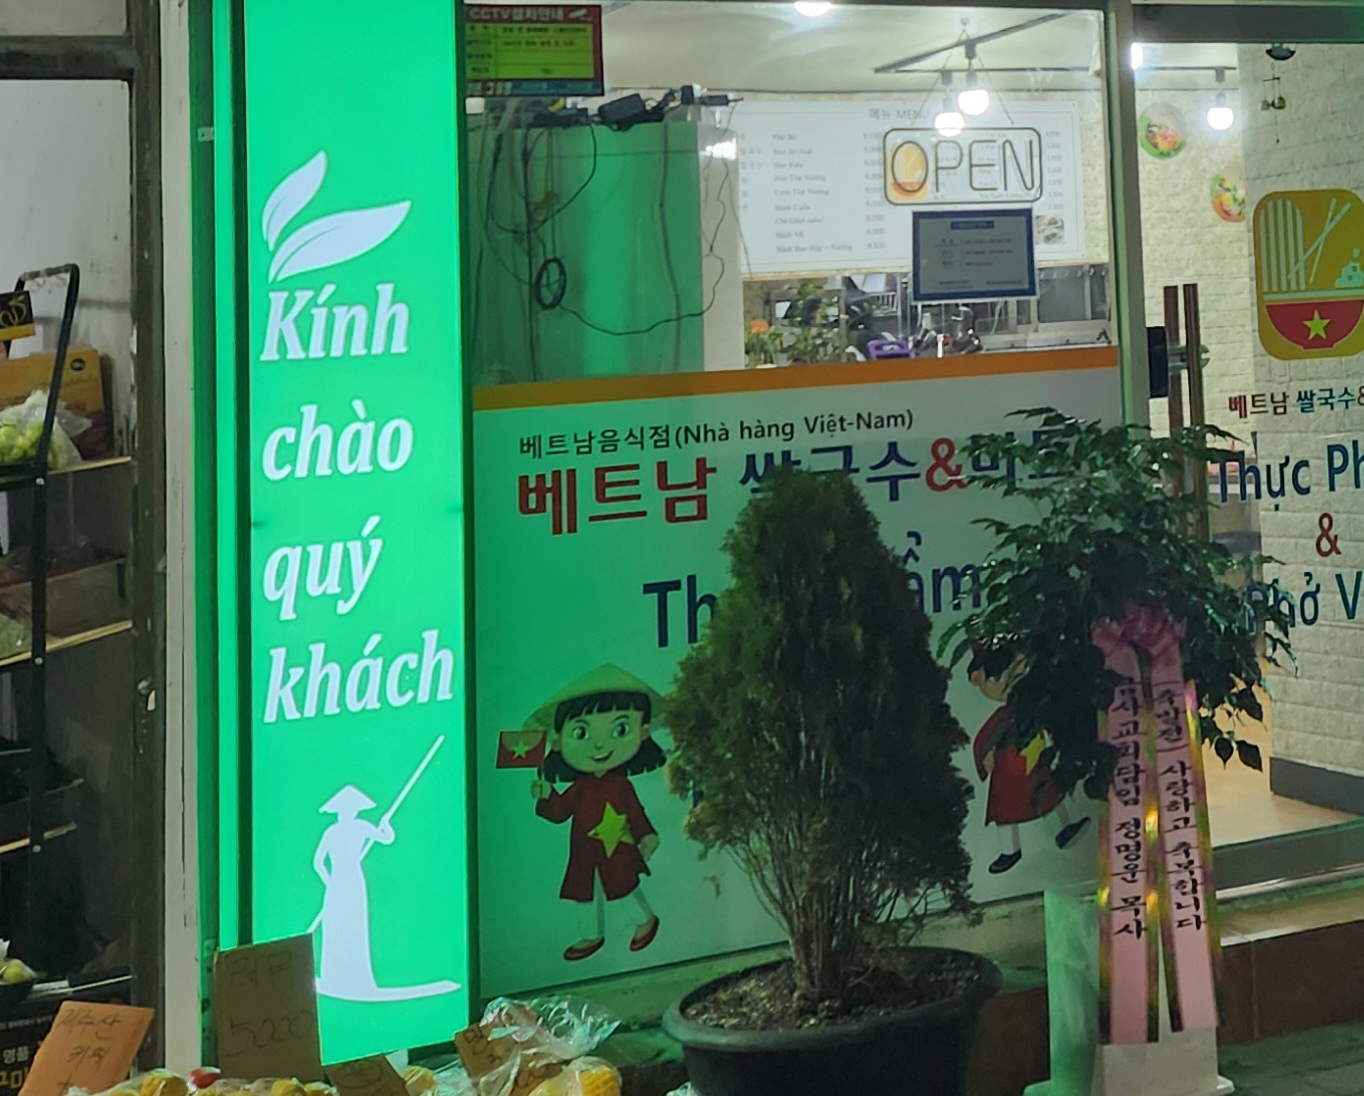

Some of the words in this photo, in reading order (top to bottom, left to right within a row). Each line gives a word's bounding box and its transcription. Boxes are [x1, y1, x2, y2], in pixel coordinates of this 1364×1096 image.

[891, 139, 1035, 193] OPEN
[259, 282, 411, 362] Kính
[262, 398, 414, 482] chào
[739, 417, 796, 444] hàng
[803, 408, 915, 436] Việt-Nam)
[1228, 391, 1290, 419] 베트남
[516, 455, 718, 535] 베트남
[262, 514, 383, 621] quý
[1315, 512, 1342, 558] &
[641, 574, 717, 648] Th
[262, 628, 456, 725] khách
[1158, 760, 1198, 834] 사랑하고
[1109, 894, 1149, 940] 목사
